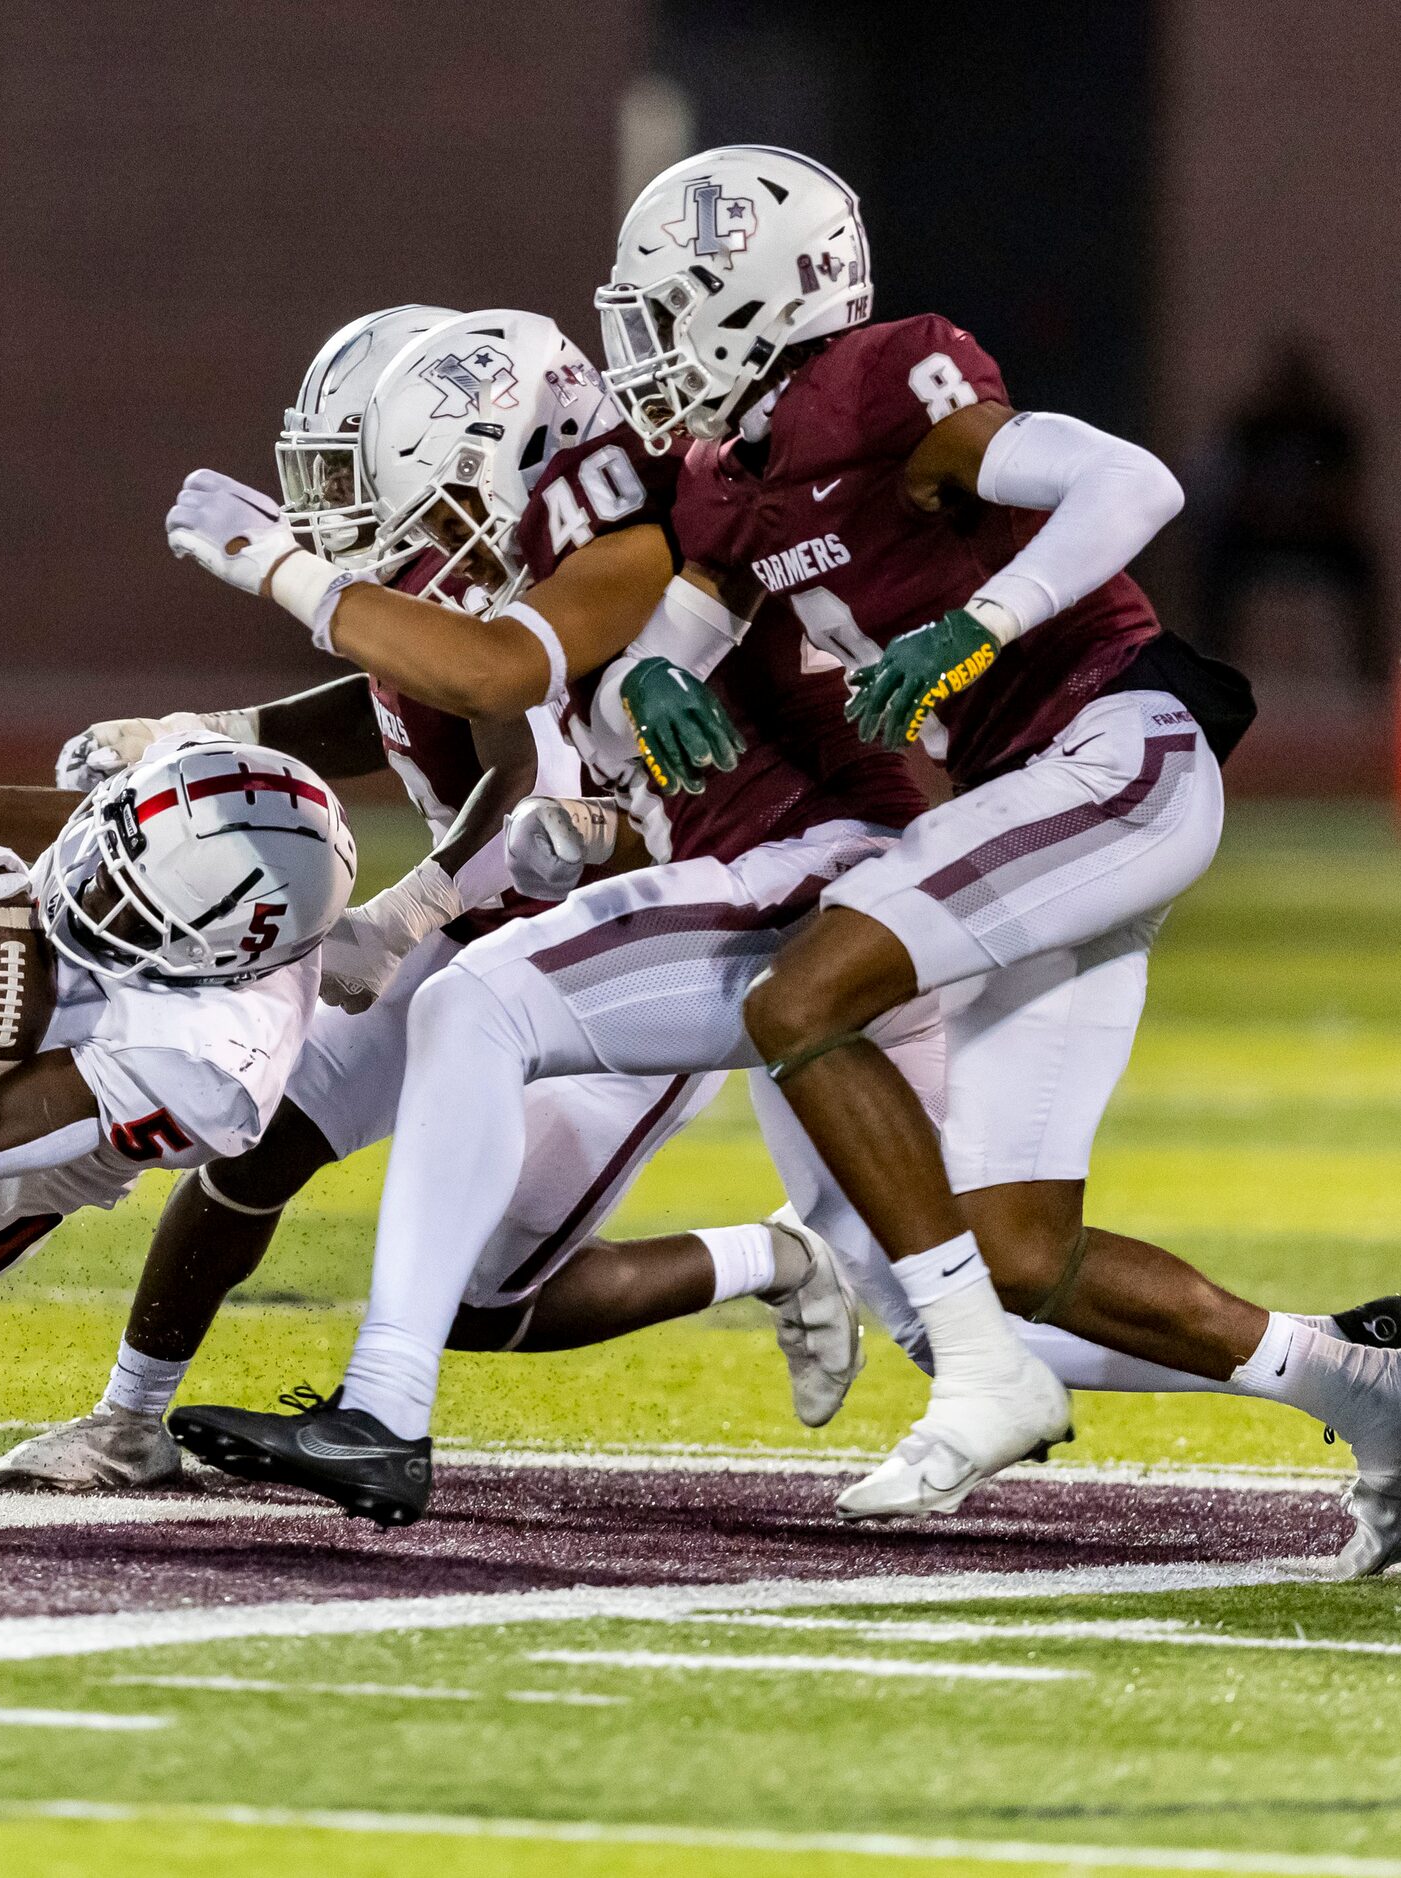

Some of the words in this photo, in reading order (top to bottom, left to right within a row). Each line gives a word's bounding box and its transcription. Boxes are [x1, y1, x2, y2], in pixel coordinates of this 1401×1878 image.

[846, 295, 869, 324] THE
[907, 351, 979, 425] 8
[541, 443, 648, 556] 40
[751, 532, 852, 593] FARMERS
[946, 642, 994, 692] BEARS
[238, 903, 288, 953] 5
[110, 1106, 194, 1162] 5
